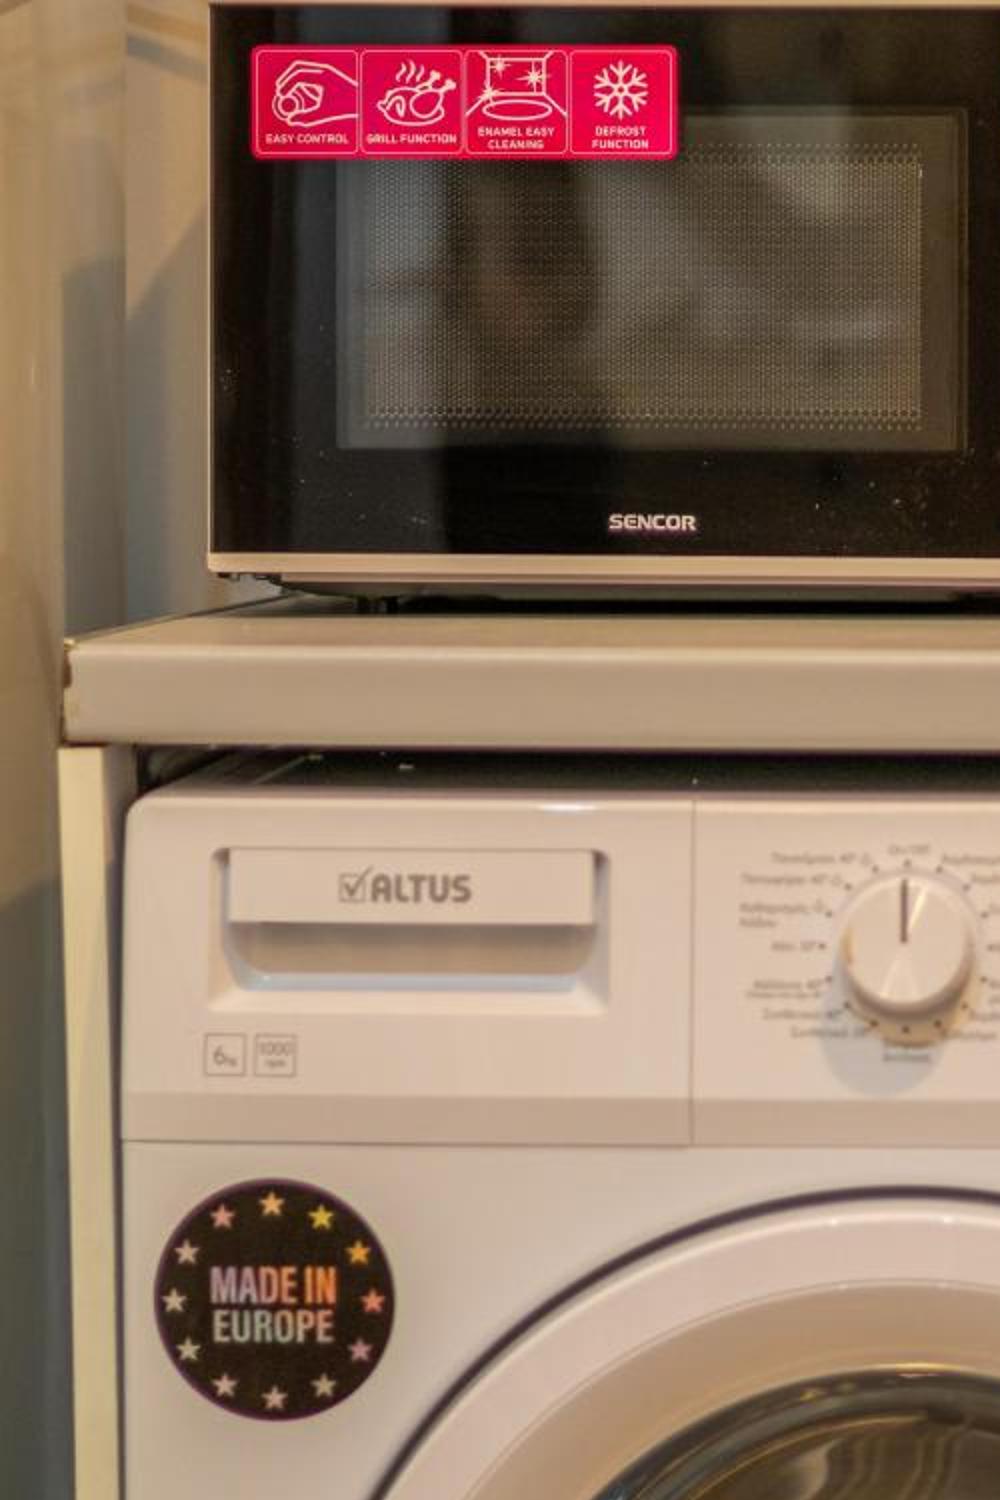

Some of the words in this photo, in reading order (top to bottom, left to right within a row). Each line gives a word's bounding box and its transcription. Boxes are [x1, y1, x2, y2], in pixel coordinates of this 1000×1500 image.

[477, 126, 523, 137] ENAMEL
[525, 126, 555, 137] EASY
[595, 125, 646, 137] DEFROST
[265, 133, 294, 144] EASY
[297, 133, 349, 144] CONTROL
[366, 133, 398, 144] GRILL
[400, 133, 457, 144] FUNCTION
[487, 139, 544, 149] CLEANING
[592, 139, 648, 149] FUNCTION
[609, 513, 697, 531] SENCOR
[371, 873, 472, 904] ALTUS
[209, 1266, 297, 1305] MADE
[304, 1266, 337, 1305] IN
[213, 1309, 334, 1343] EUROPE
